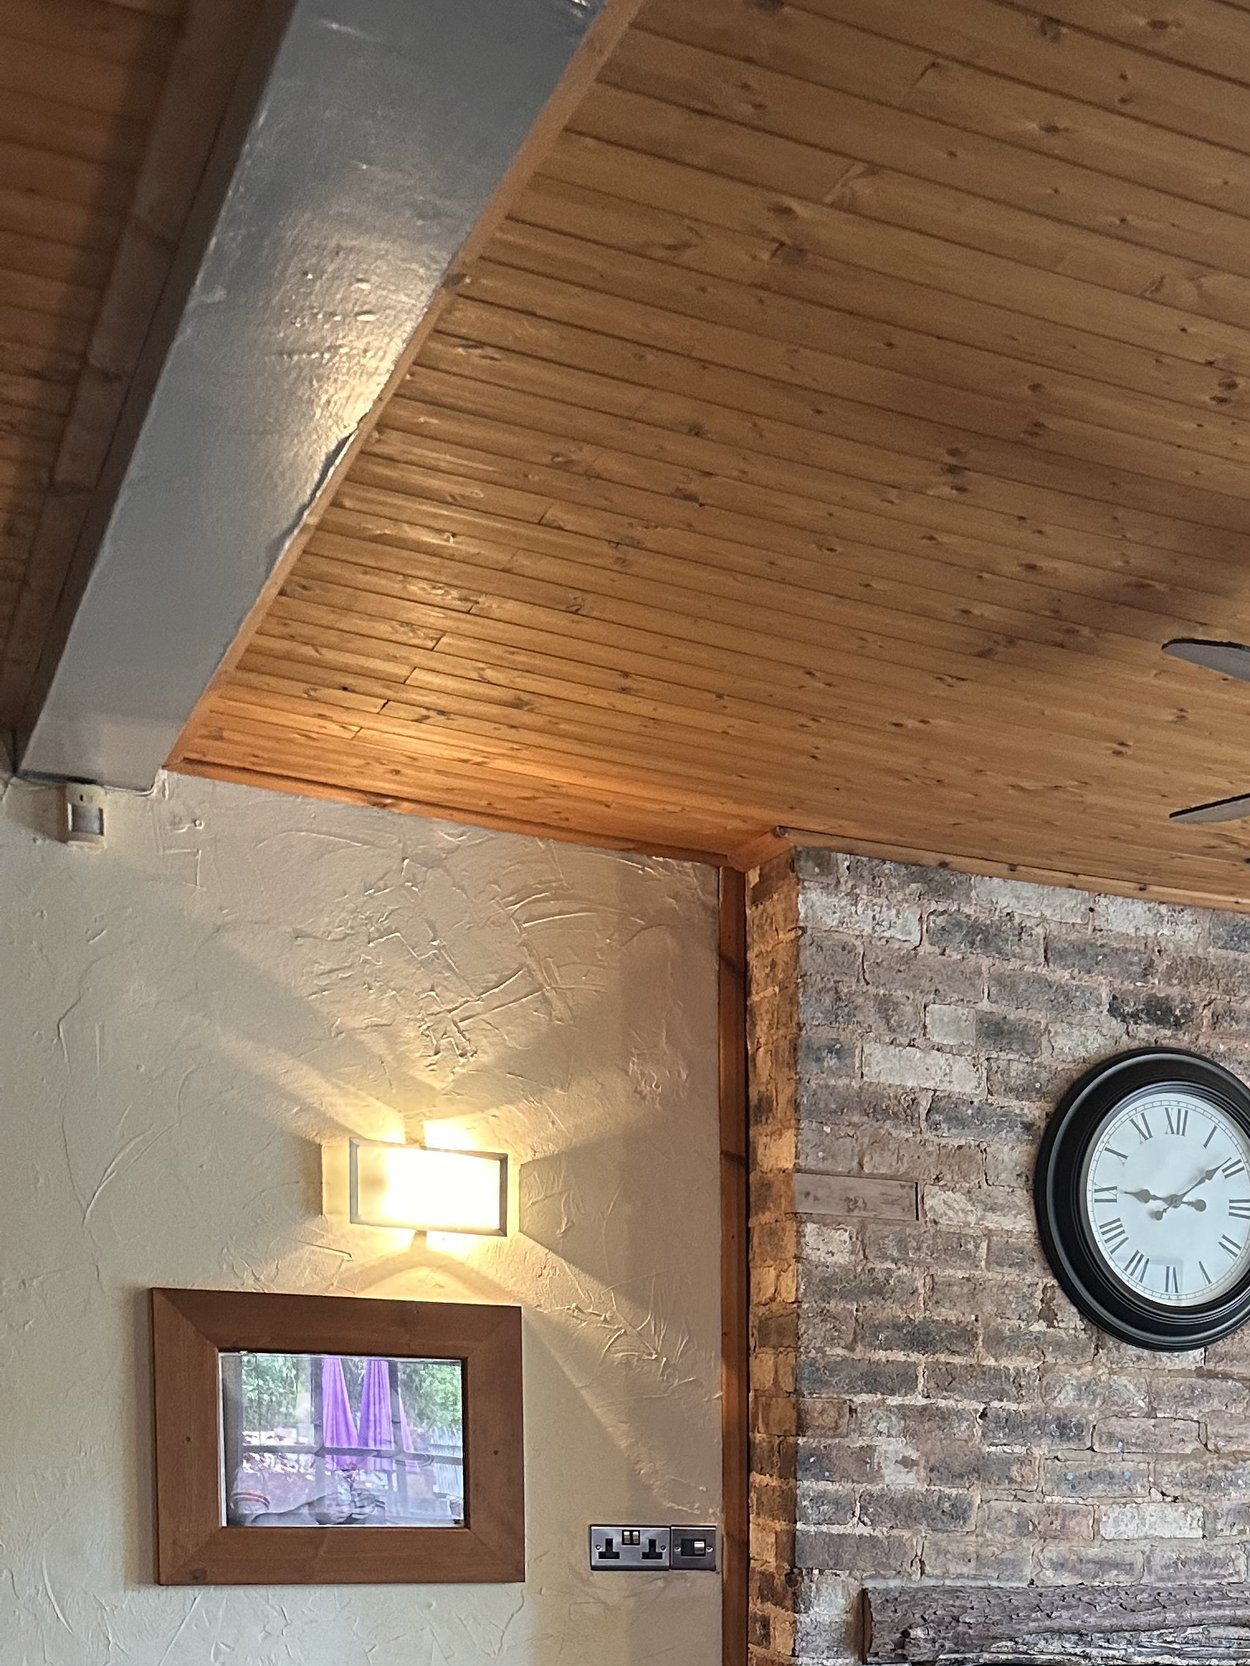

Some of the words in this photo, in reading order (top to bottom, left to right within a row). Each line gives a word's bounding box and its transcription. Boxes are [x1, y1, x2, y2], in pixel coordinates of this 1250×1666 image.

[1129, 1112, 1154, 1144] XI
[1165, 1107, 1189, 1136] XII
[1203, 1125, 1218, 1148] I
[1222, 1158, 1245, 1179] II
[1094, 1181, 1118, 1204] IX
[1228, 1199, 1250, 1219] III
[1099, 1217, 1129, 1255] VIII
[1218, 1234, 1242, 1261] IV
[1124, 1250, 1149, 1283] VII
[1164, 1265, 1179, 1294] VI
